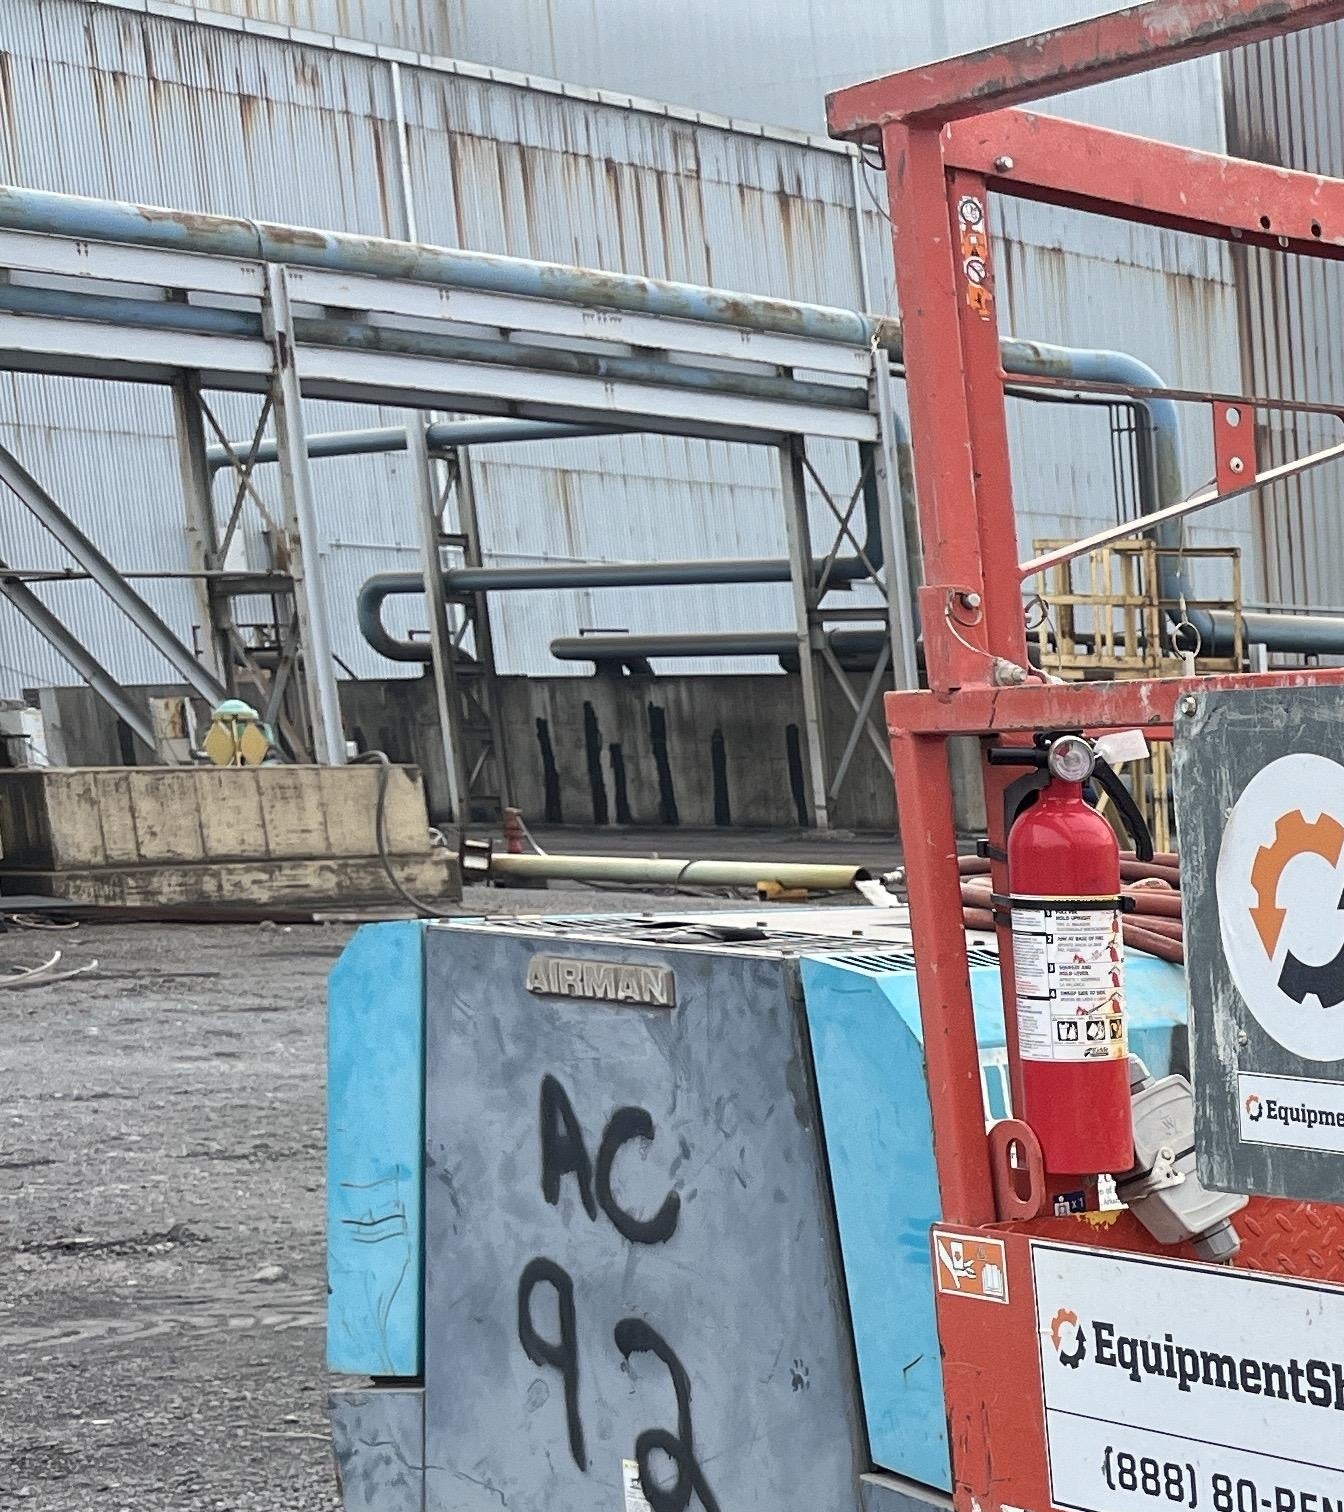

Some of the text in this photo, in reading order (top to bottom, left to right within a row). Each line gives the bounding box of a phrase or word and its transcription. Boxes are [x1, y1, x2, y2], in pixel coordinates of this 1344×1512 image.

[527, 956, 669, 1004] AIRMAN
[541, 1073, 682, 1245] AC
[1103, 1445, 1199, 1510] (888)
